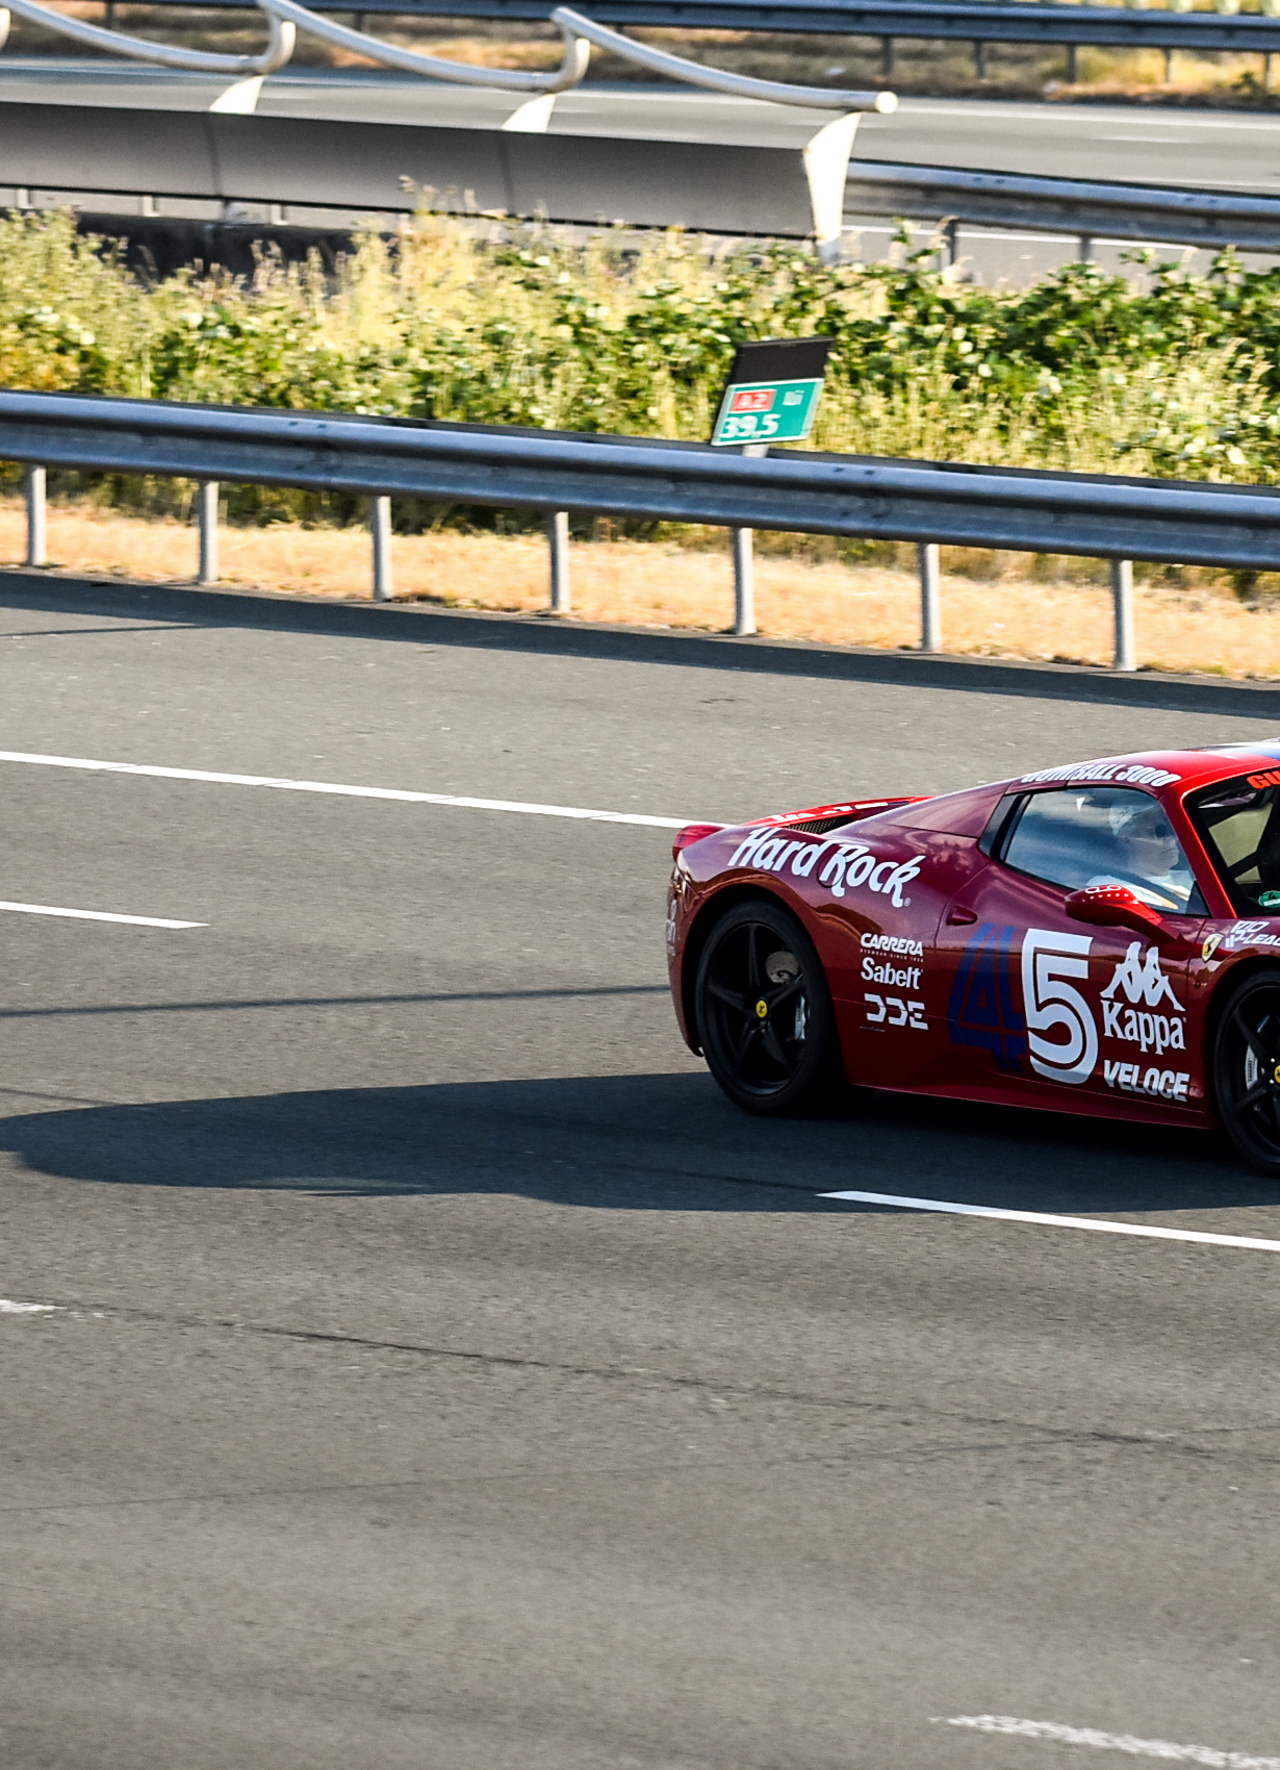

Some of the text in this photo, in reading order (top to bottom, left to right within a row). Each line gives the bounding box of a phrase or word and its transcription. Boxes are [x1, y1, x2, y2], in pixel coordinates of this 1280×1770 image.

[1021, 763, 1182, 787] GUMBALL 3000
[727, 826, 926, 908] Hard Rock
[860, 932, 924, 957] CARRERA
[860, 956, 921, 990] Sabelt
[1100, 1000, 1187, 1056] Kappa
[1103, 1059, 1190, 1102] VELOCE
